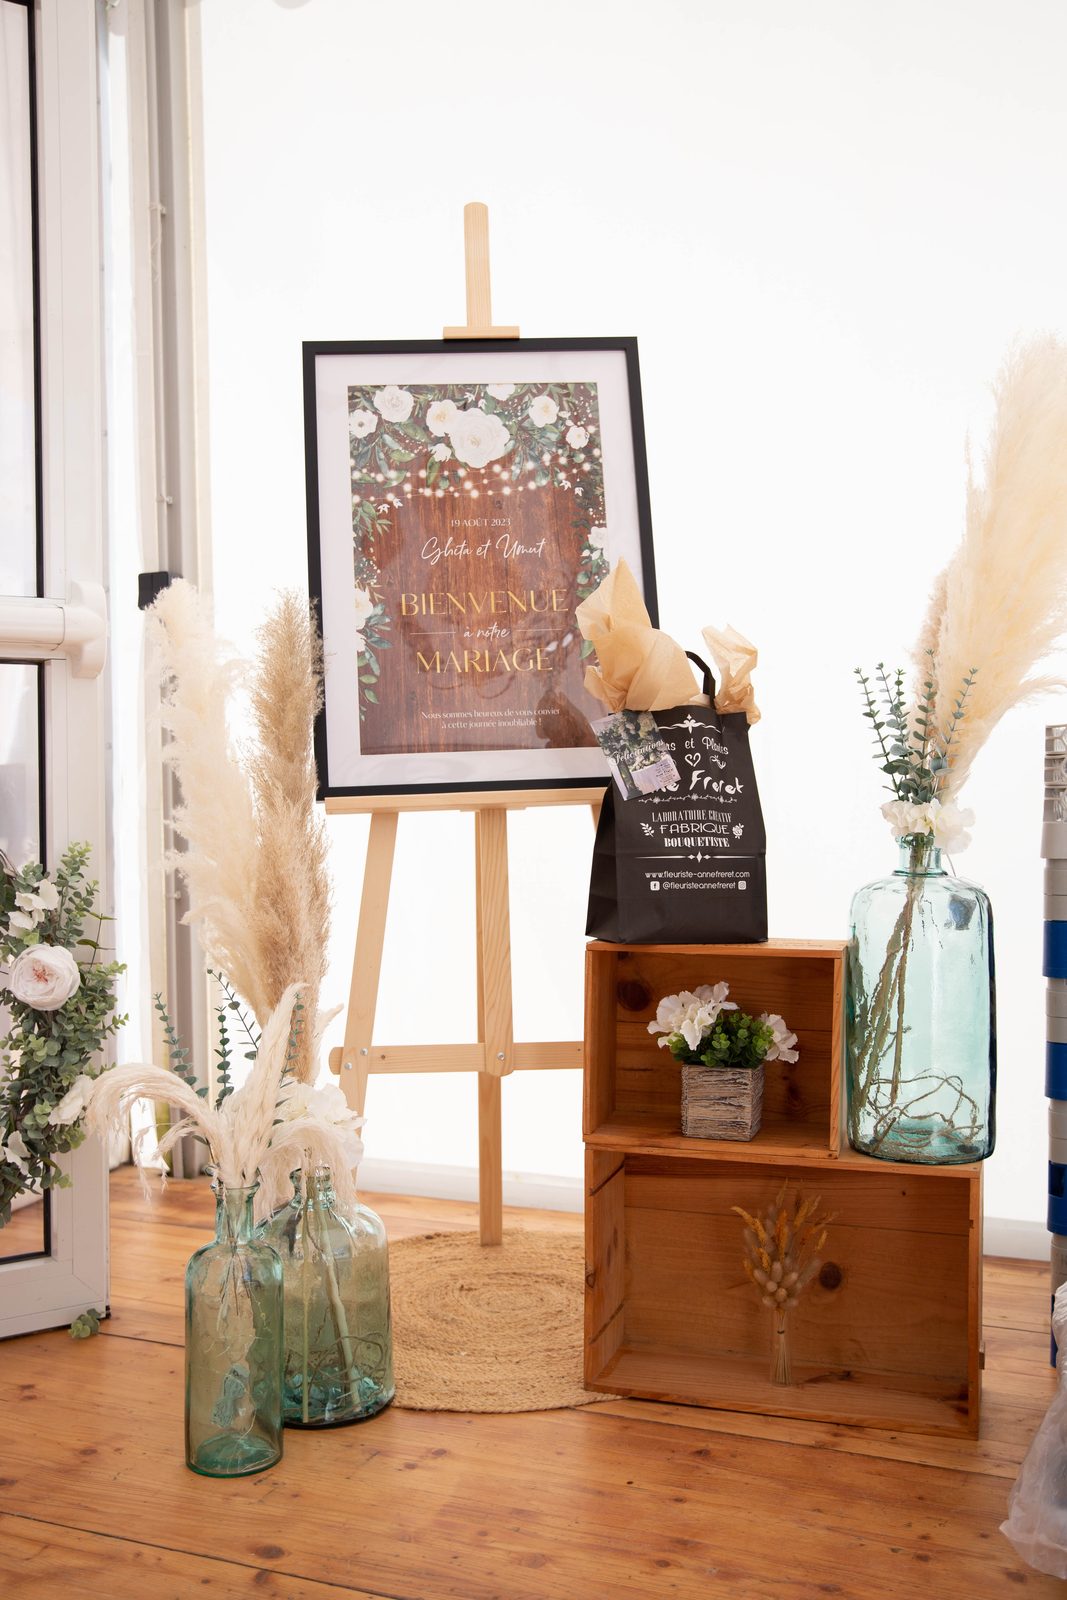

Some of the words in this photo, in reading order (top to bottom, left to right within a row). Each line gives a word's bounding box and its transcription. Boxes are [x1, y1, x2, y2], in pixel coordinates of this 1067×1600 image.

[451, 519, 460, 527] 19
[491, 518, 511, 527] 2023
[421, 536, 473, 565] Ghita
[476, 539, 492, 559] et
[496, 533, 547, 559] Umut
[401, 589, 569, 616] BIENVENUE
[463, 625, 474, 638] à
[477, 622, 511, 640] notre
[416, 647, 553, 674] MARIAGE
[421, 711, 441, 719] Nous
[473, 709, 504, 717] heureux
[506, 708, 514, 716] de
[534, 708, 560, 716] convier
[447, 720, 467, 728] cette
[468, 719, 497, 730] journée
[498, 717, 537, 727] inoubliable
[685, 737, 695, 749] et
[689, 769, 744, 795] Freret
[652, 809, 707, 823] LABORATOIRE
[660, 822, 730, 834] FABRIQUE
[664, 836, 730, 848] BOUQUETISTE
[645, 870, 750, 879] www.fleuriste-annefreret.com
